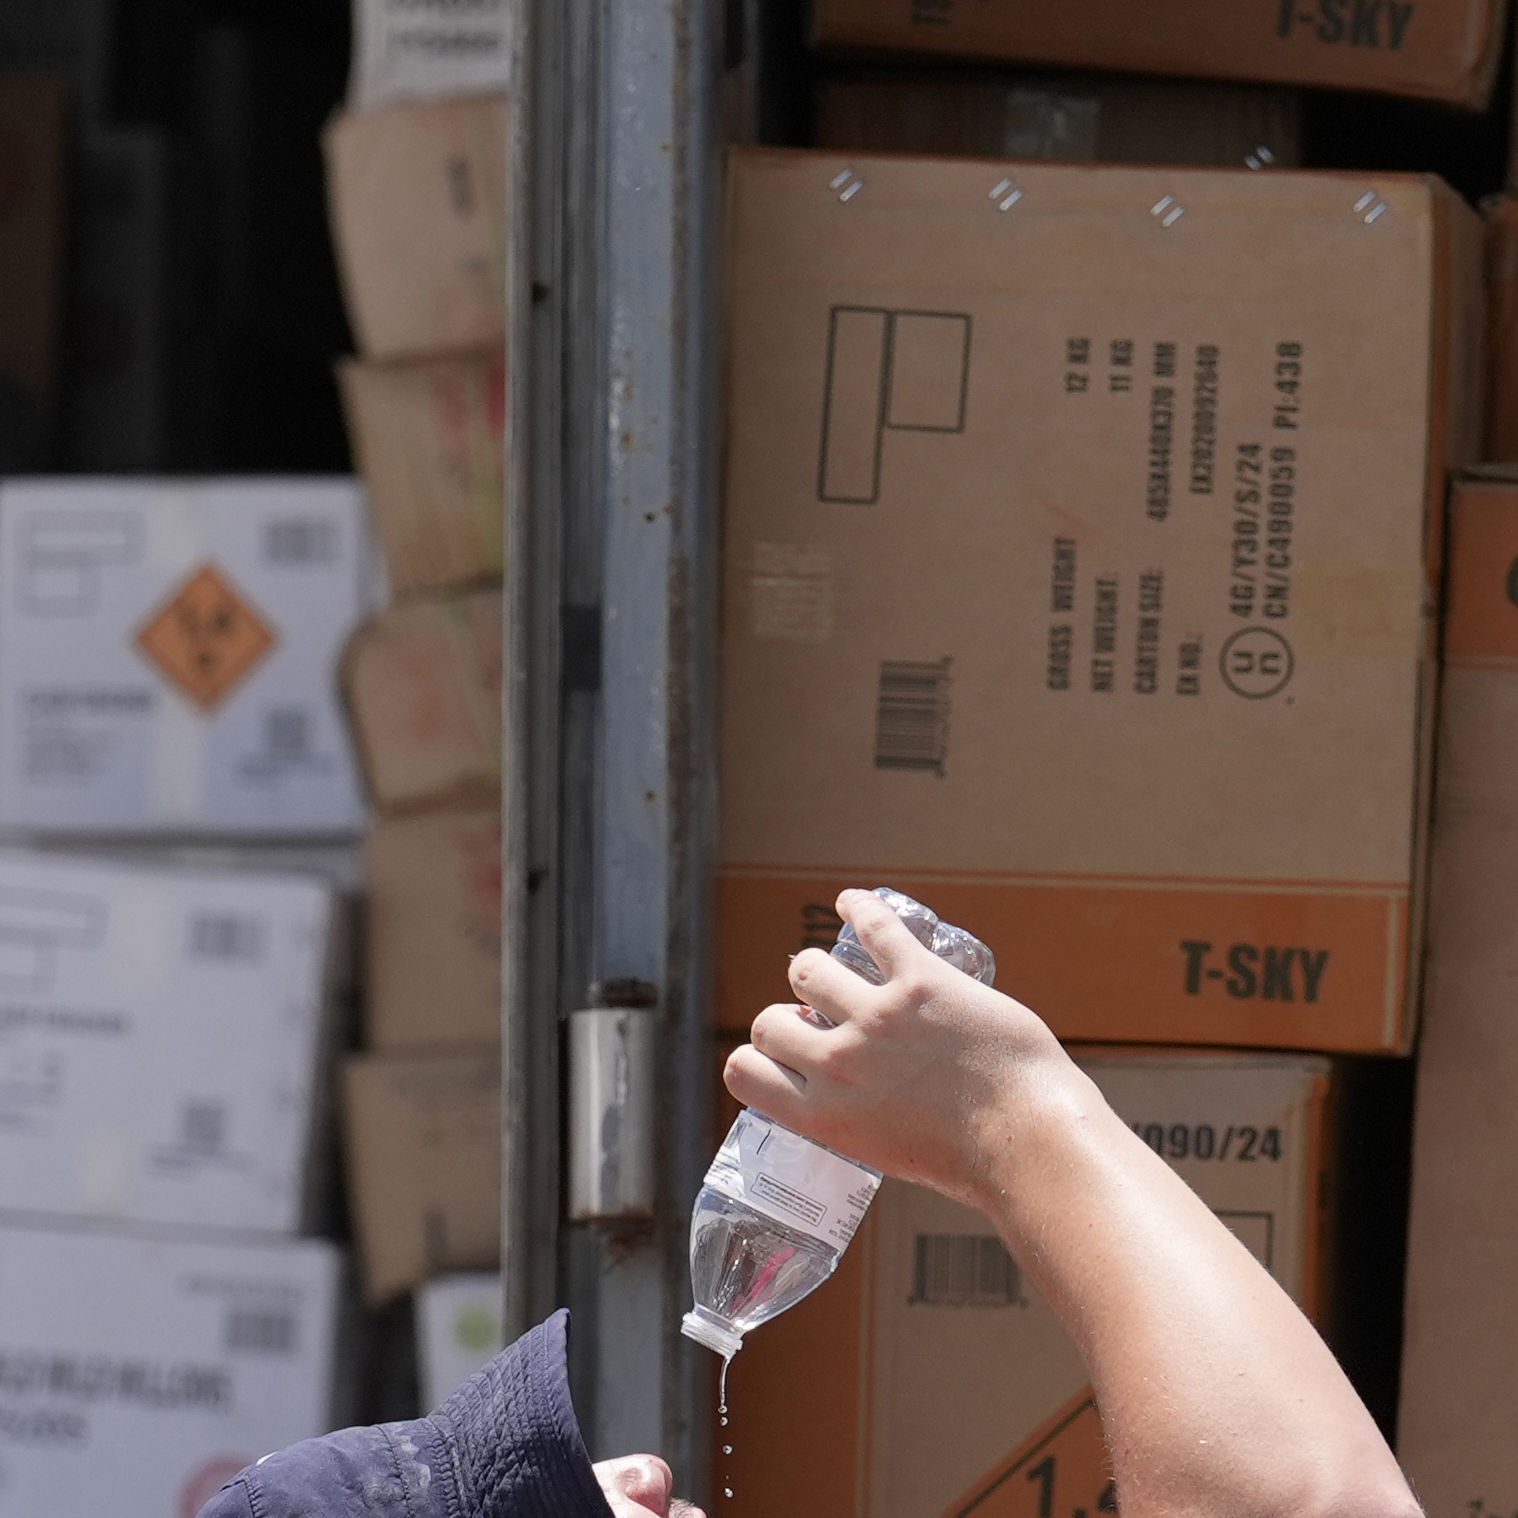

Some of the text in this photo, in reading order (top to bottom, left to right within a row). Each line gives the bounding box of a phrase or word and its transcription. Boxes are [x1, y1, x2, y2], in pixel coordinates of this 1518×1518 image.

[1064, 337, 1090, 394] 12 KG
[1110, 339, 1134, 368] KG
[1152, 341, 1178, 379] MM
[1230, 443, 1262, 618] 4G/Y30/S/24
[1046, 537, 1077, 692] GROSS WEIGHT
[1090, 659, 1114, 693] NET
[1133, 617, 1160, 695] CARTON
[1181, 938, 1332, 1004] T-SKY
